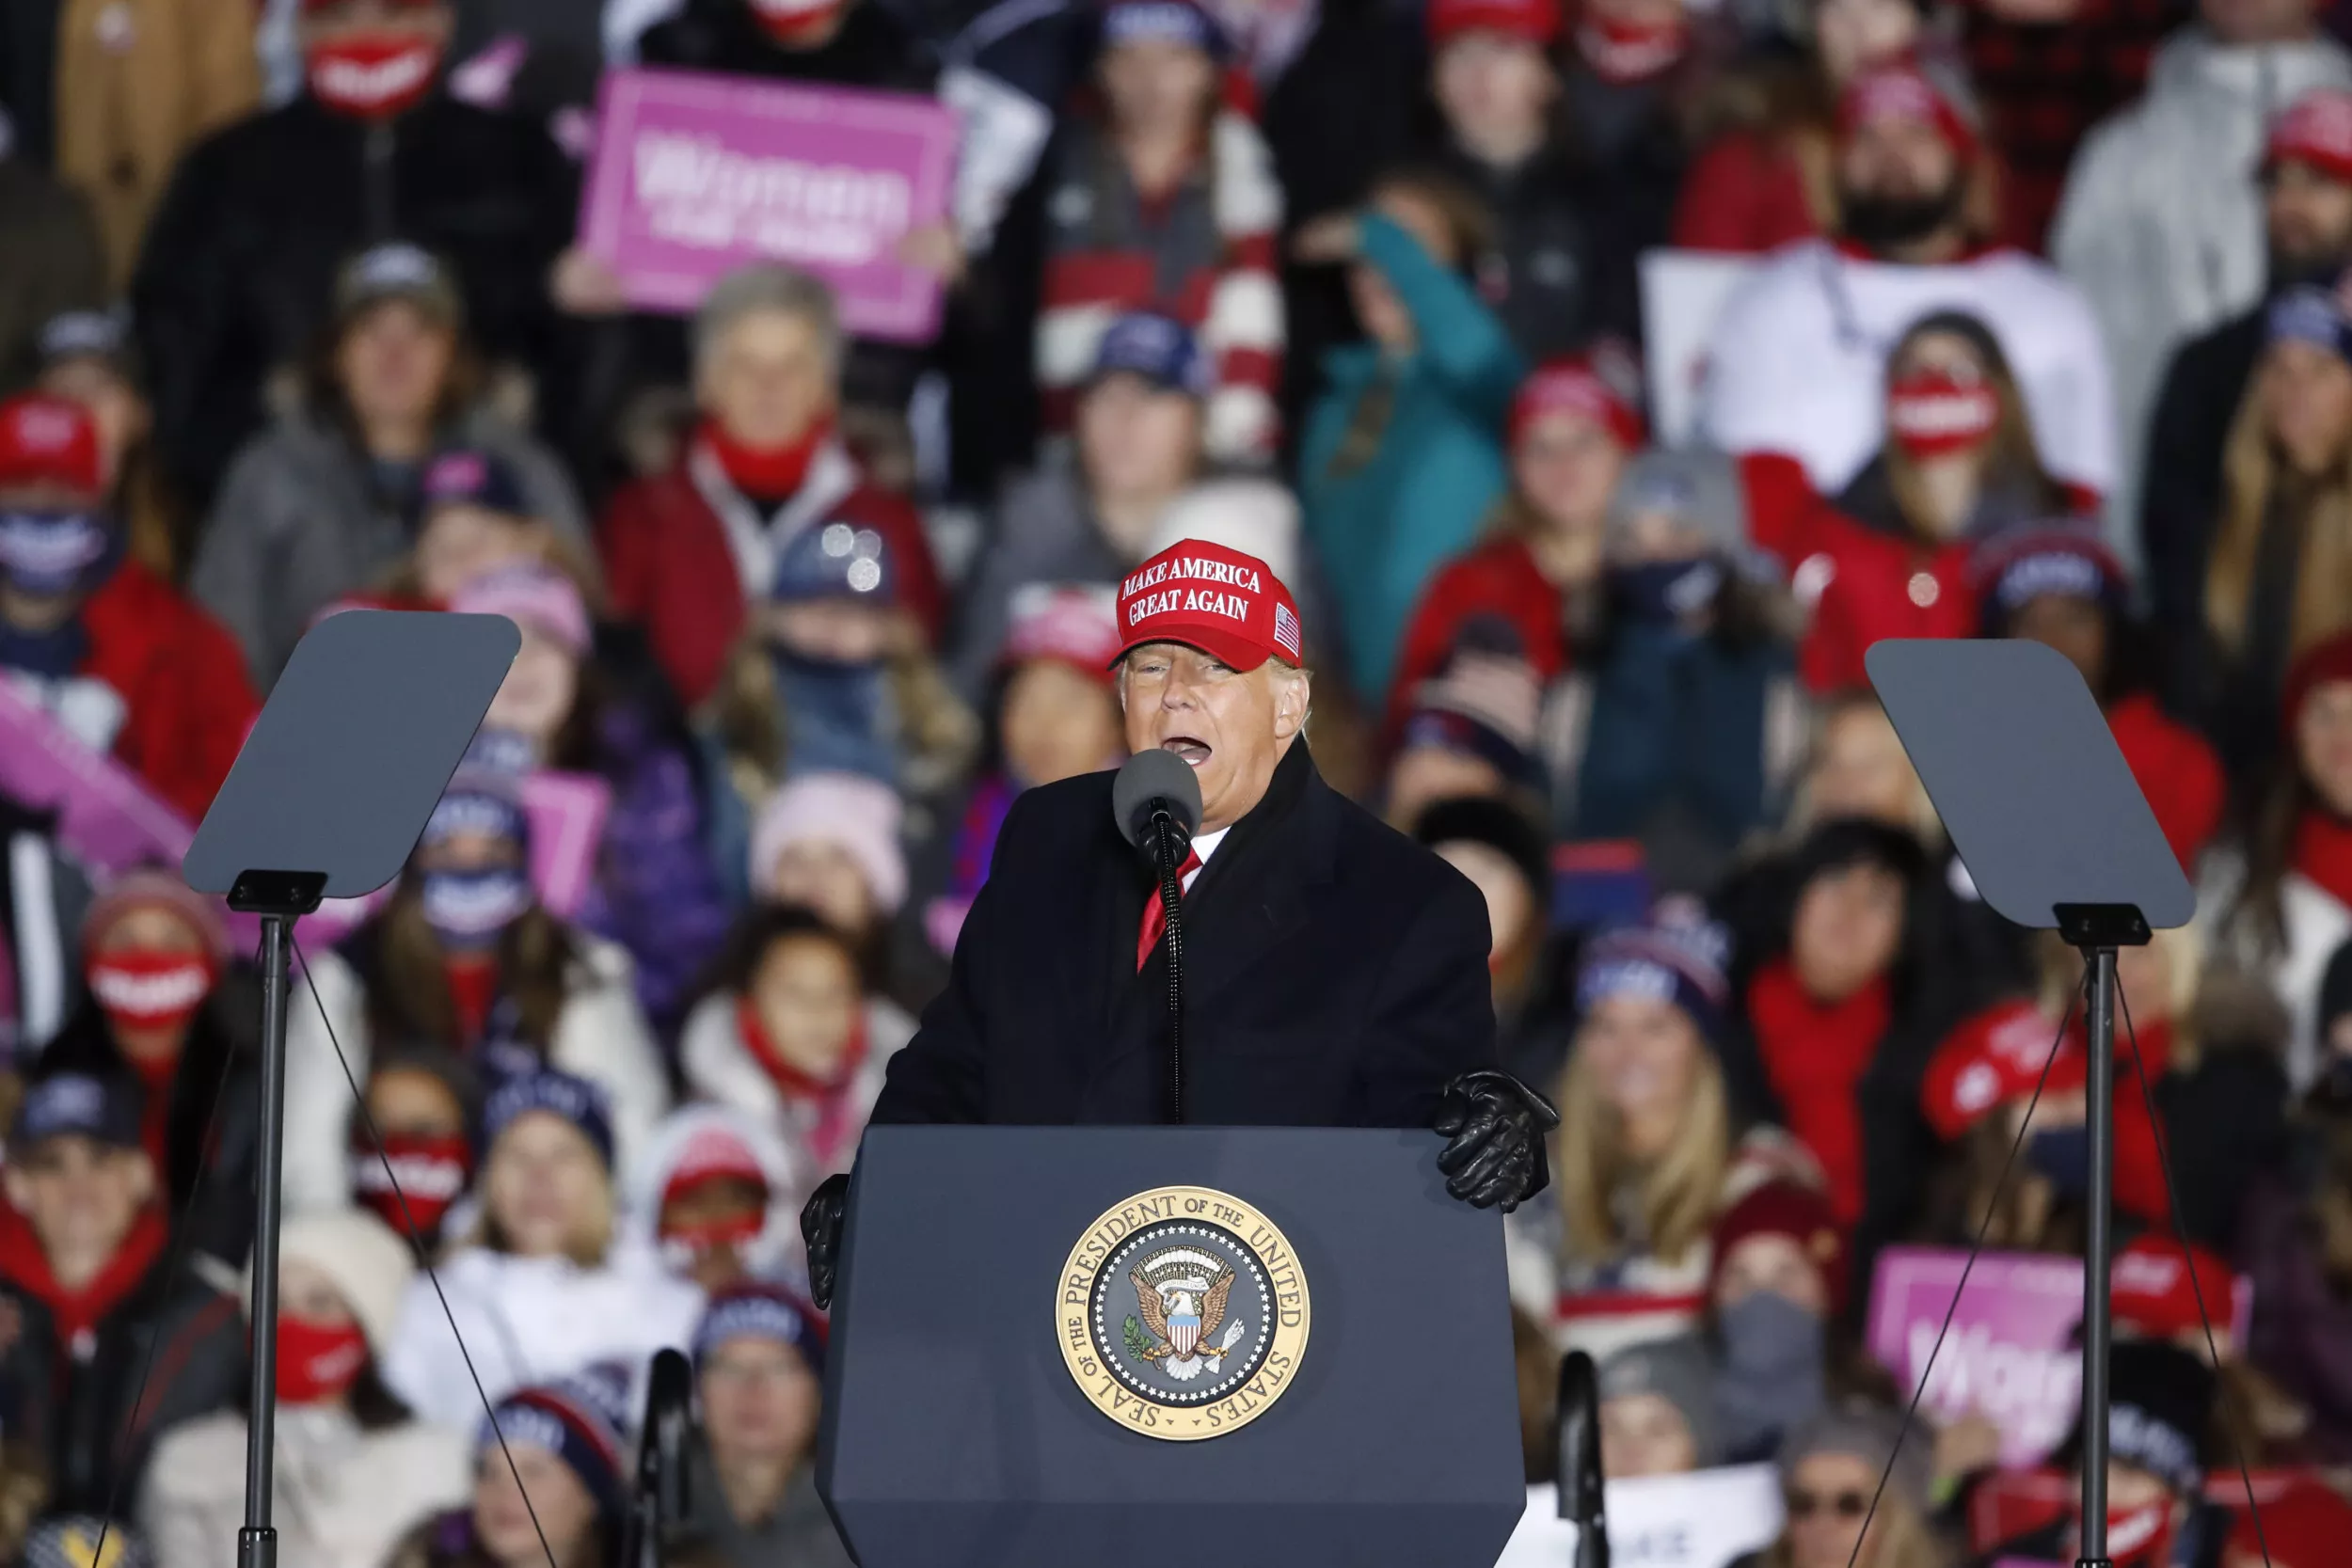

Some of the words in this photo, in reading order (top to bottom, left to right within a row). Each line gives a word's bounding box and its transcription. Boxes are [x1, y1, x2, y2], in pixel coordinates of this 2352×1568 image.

[1122, 562, 1168, 601] MAKE
[1168, 558, 1260, 594] AMERICA
[1129, 589, 1182, 626] GREAT
[1184, 589, 1248, 623] AGAIN
[1184, 1198, 1209, 1213] OF
[1214, 1204, 1245, 1227] THE
[1065, 1196, 1177, 1307] PRESIDENT
[1250, 1225, 1302, 1328] UNITED
[1068, 1315, 1087, 1351] THE
[1078, 1355, 1098, 1377] OF
[1908, 1319, 2085, 1425] Wom
[1098, 1375, 1160, 1427] SEAL
[1206, 1351, 1291, 1428] STATES
